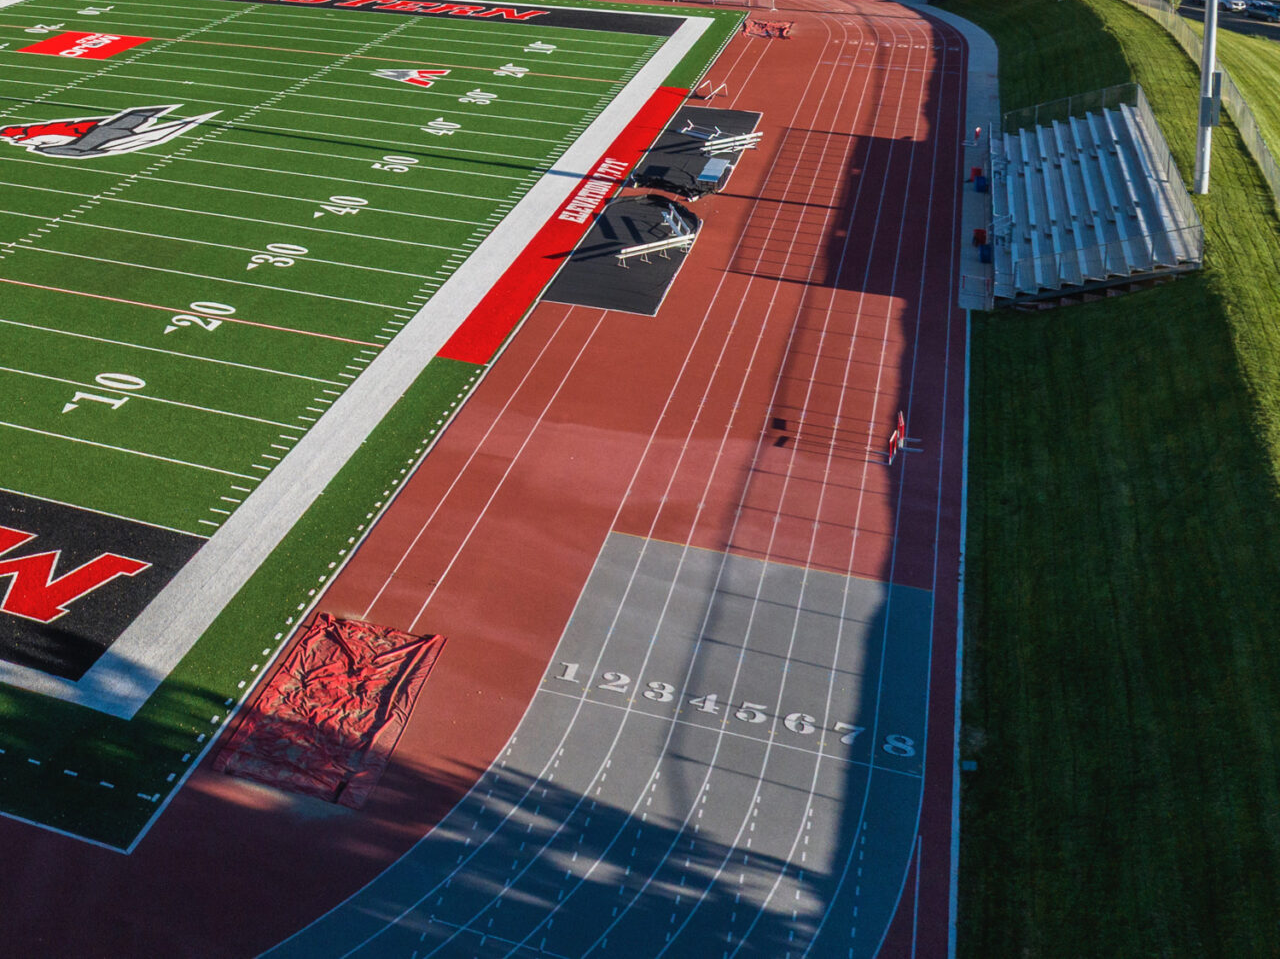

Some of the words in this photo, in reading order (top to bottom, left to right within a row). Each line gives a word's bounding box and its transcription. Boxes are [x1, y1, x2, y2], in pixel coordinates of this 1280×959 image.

[523, 43, 557, 54] 10
[493, 65, 529, 78] 20
[458, 91, 498, 105] 30
[420, 120, 461, 136] 40
[371, 155, 419, 172] 50
[320, 195, 368, 217] 40
[558, 179, 613, 224] ELEVATION
[251, 243, 308, 268] 30
[171, 301, 236, 332] 20
[71, 372, 146, 410] 10
[554, 662, 581, 683] 1
[597, 671, 631, 693] 2
[643, 681, 676, 703] 3
[689, 693, 720, 715] 4
[735, 701, 767, 724] 5
[783, 712, 816, 735] 6
[833, 721, 865, 744] 7
[883, 733, 916, 758] 8
